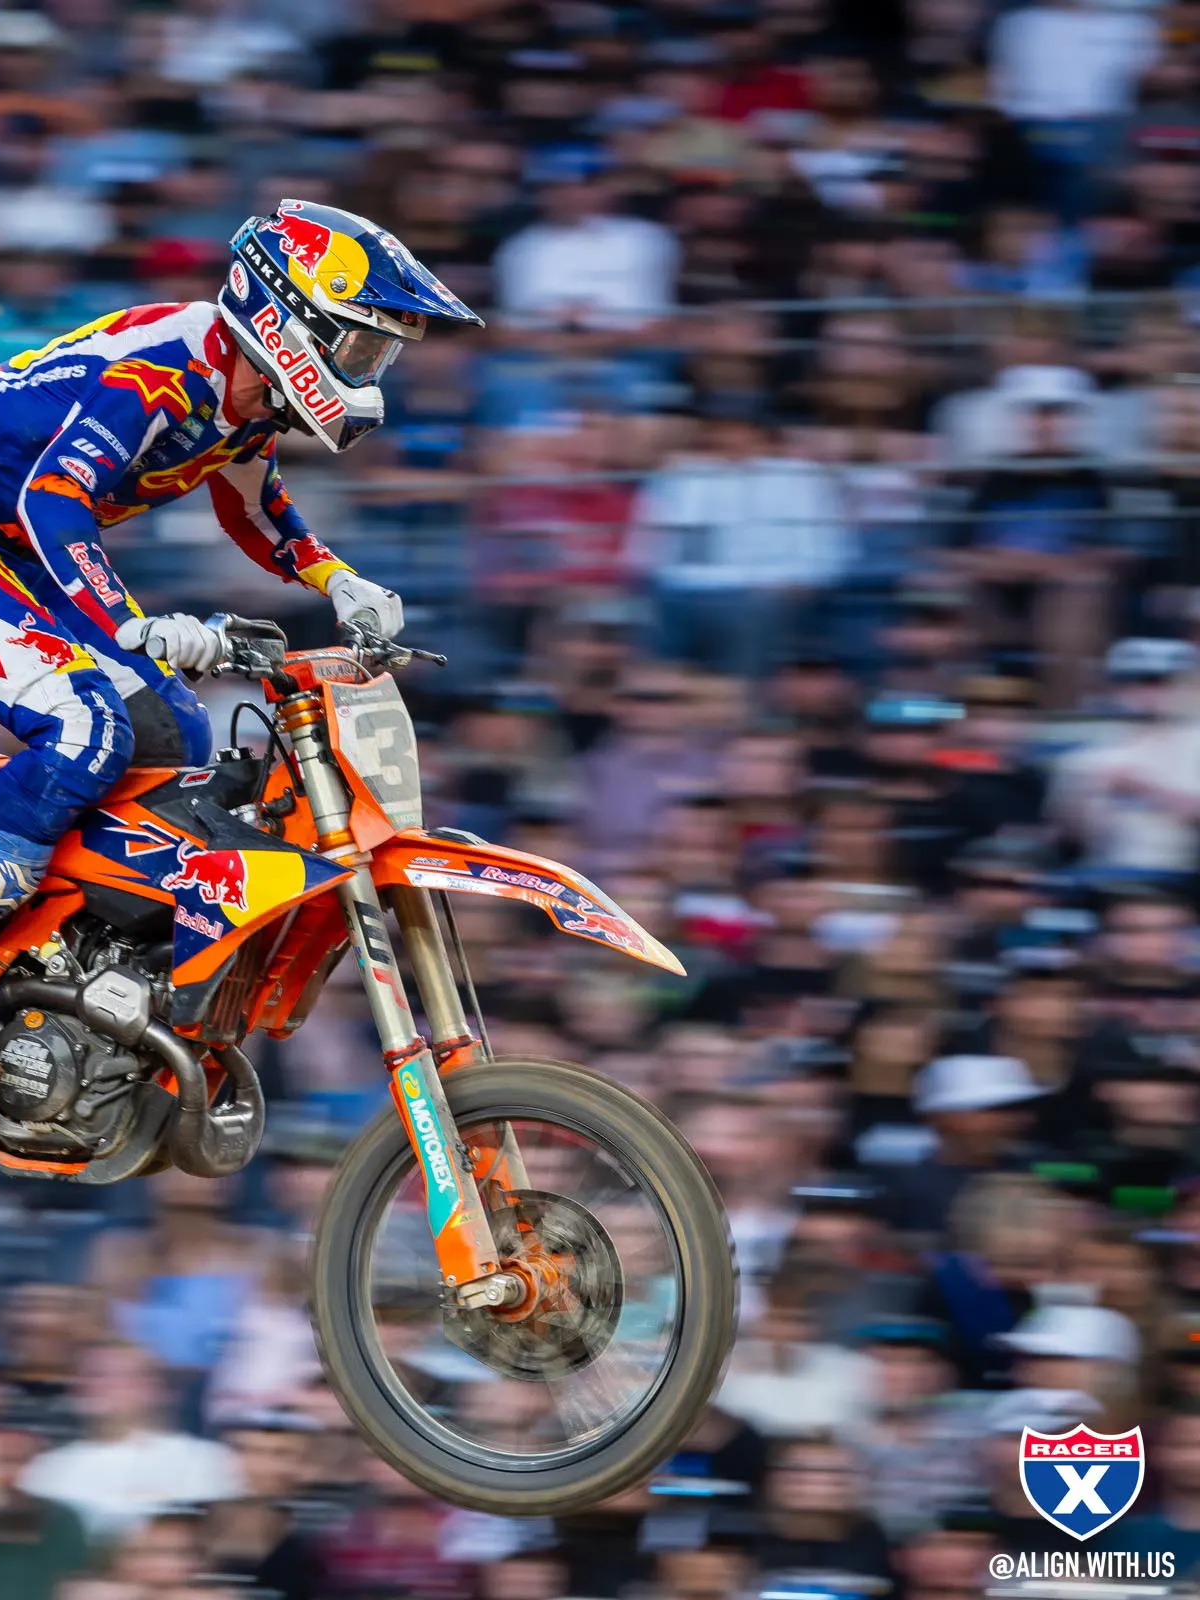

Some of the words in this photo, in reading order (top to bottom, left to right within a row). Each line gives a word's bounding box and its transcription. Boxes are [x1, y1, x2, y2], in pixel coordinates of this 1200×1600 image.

[232, 267, 246, 297] BELL
[245, 242, 317, 320] OAKLEY
[355, 709, 419, 803] 3
[409, 1098, 456, 1194] MOTOREX
